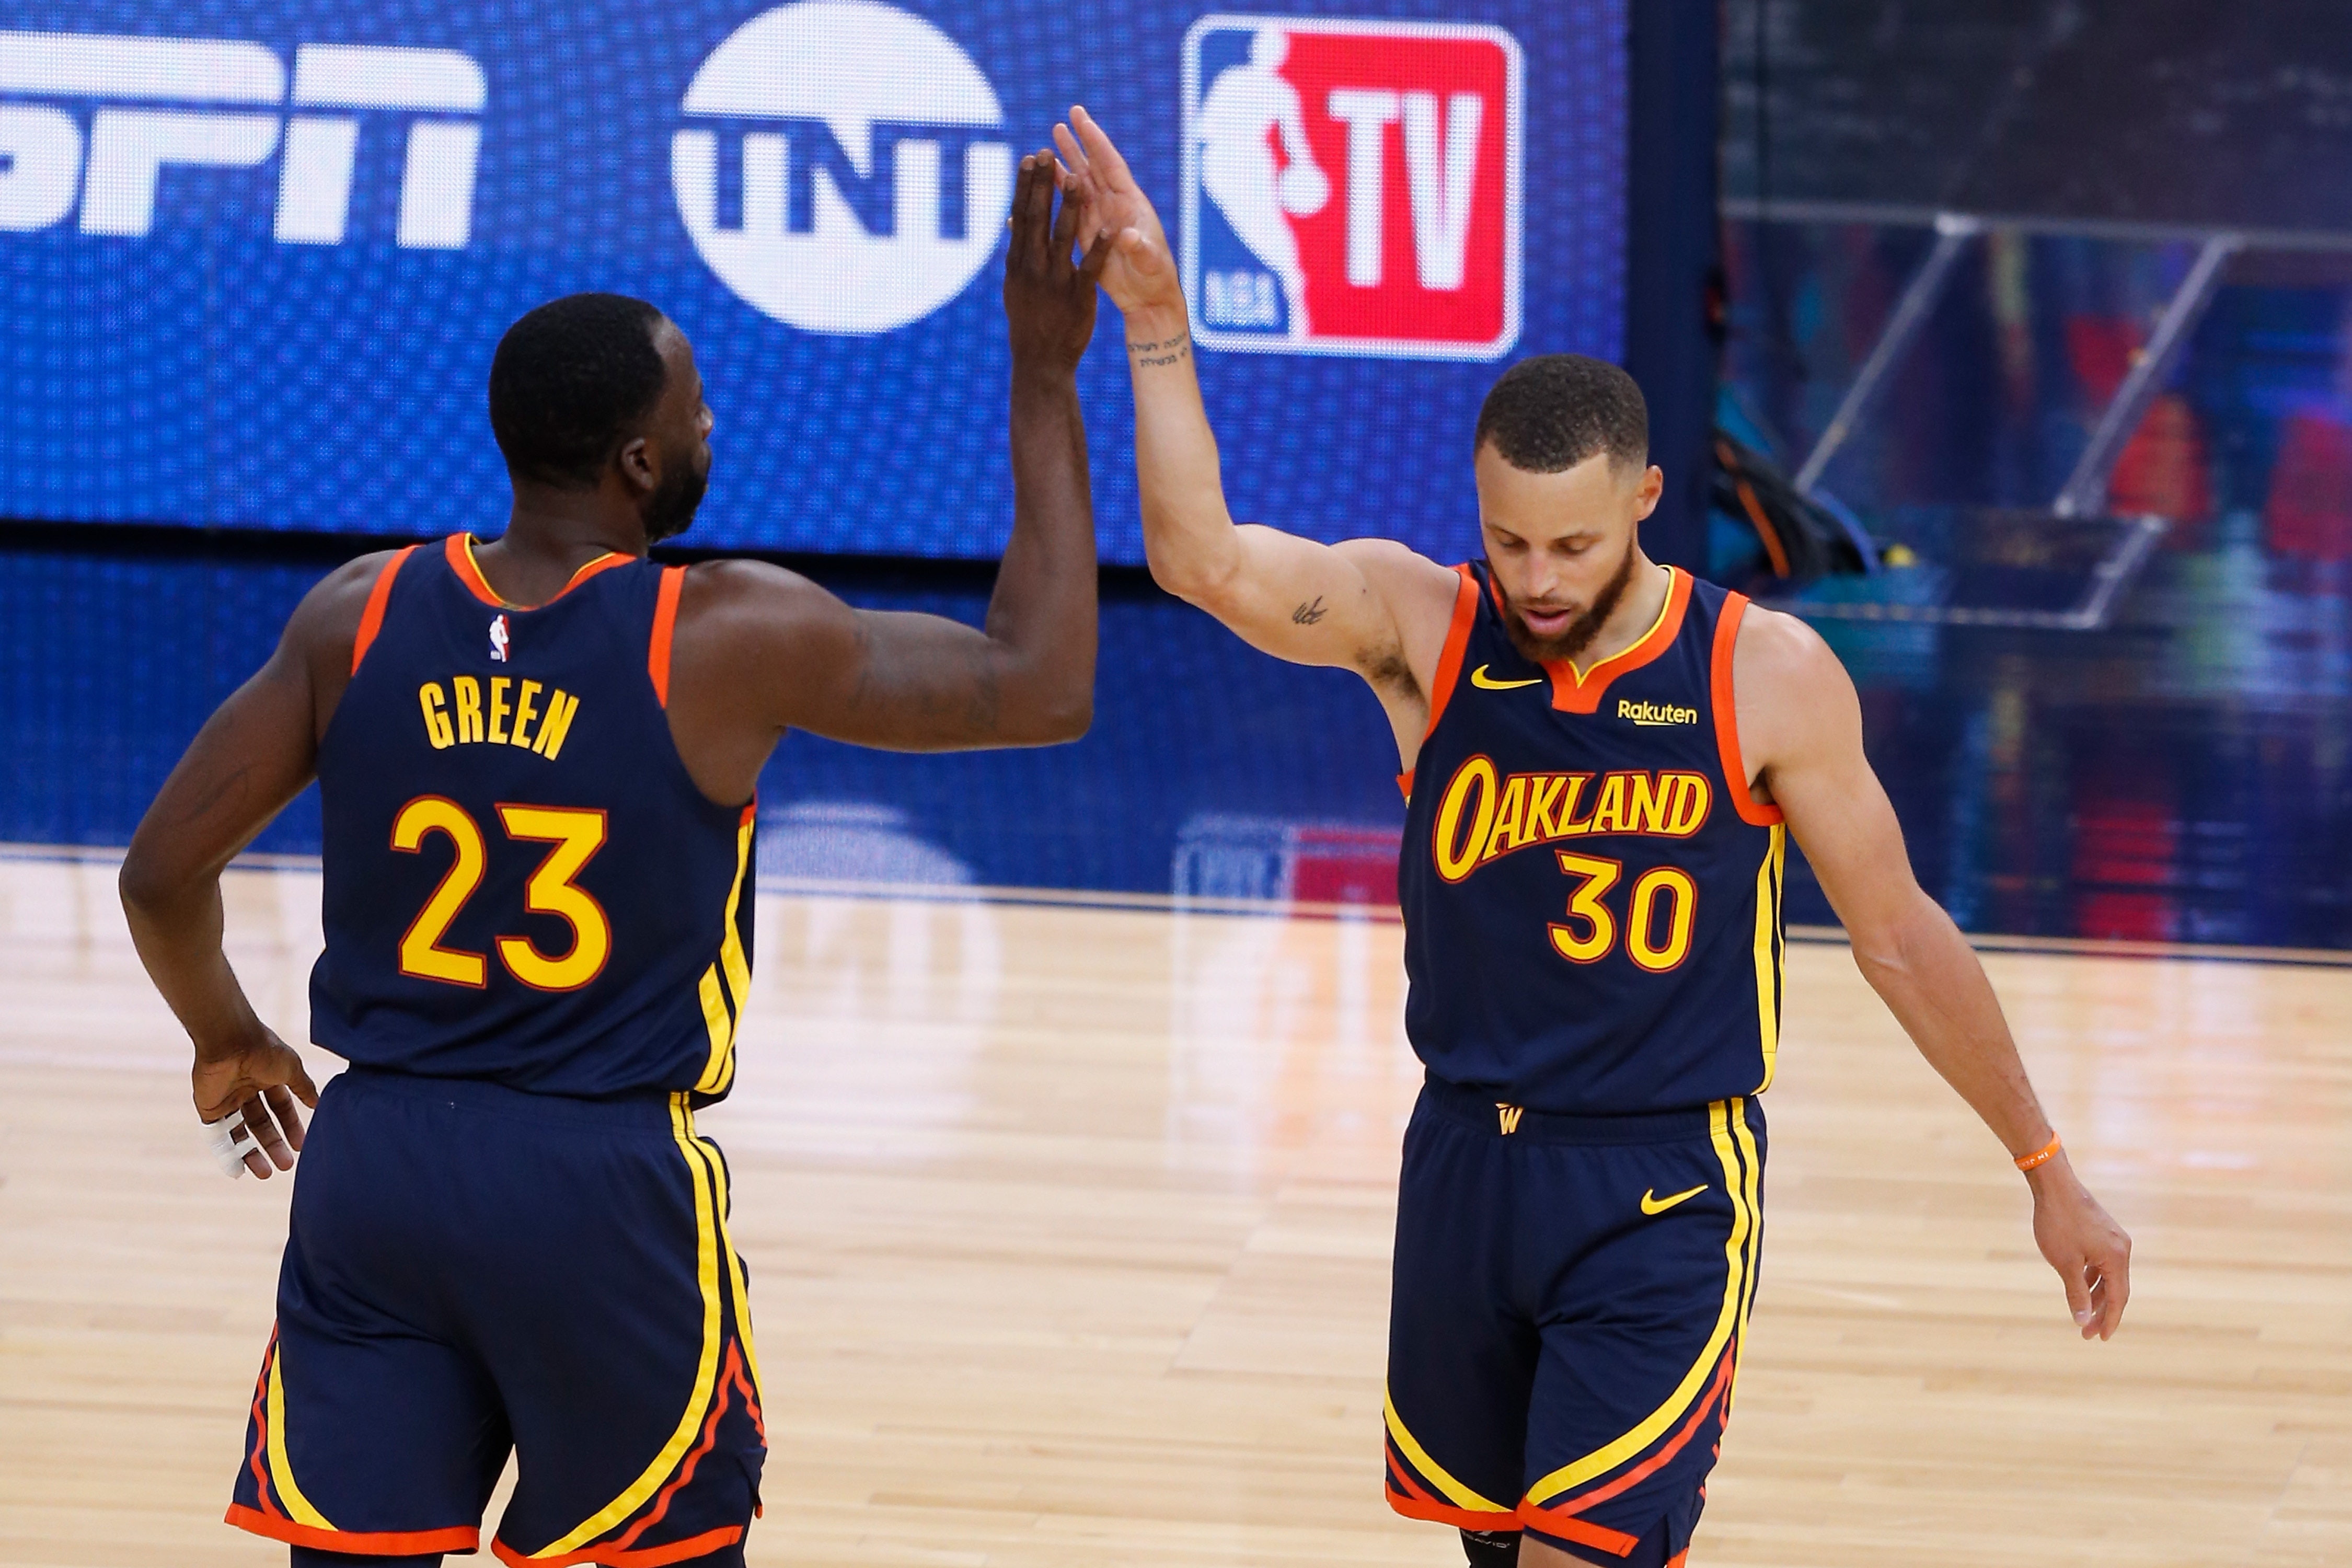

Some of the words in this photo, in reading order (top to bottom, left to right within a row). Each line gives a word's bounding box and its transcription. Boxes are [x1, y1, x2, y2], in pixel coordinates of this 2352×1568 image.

[675, 111, 1011, 240] TNT
[1328, 87, 1484, 291] TV
[419, 674, 580, 762] GREEN
[1618, 699, 1698, 725] Rakuten
[1432, 753, 1713, 884] OAKLAND
[390, 793, 612, 993] 23
[1547, 848, 1699, 974] 30
